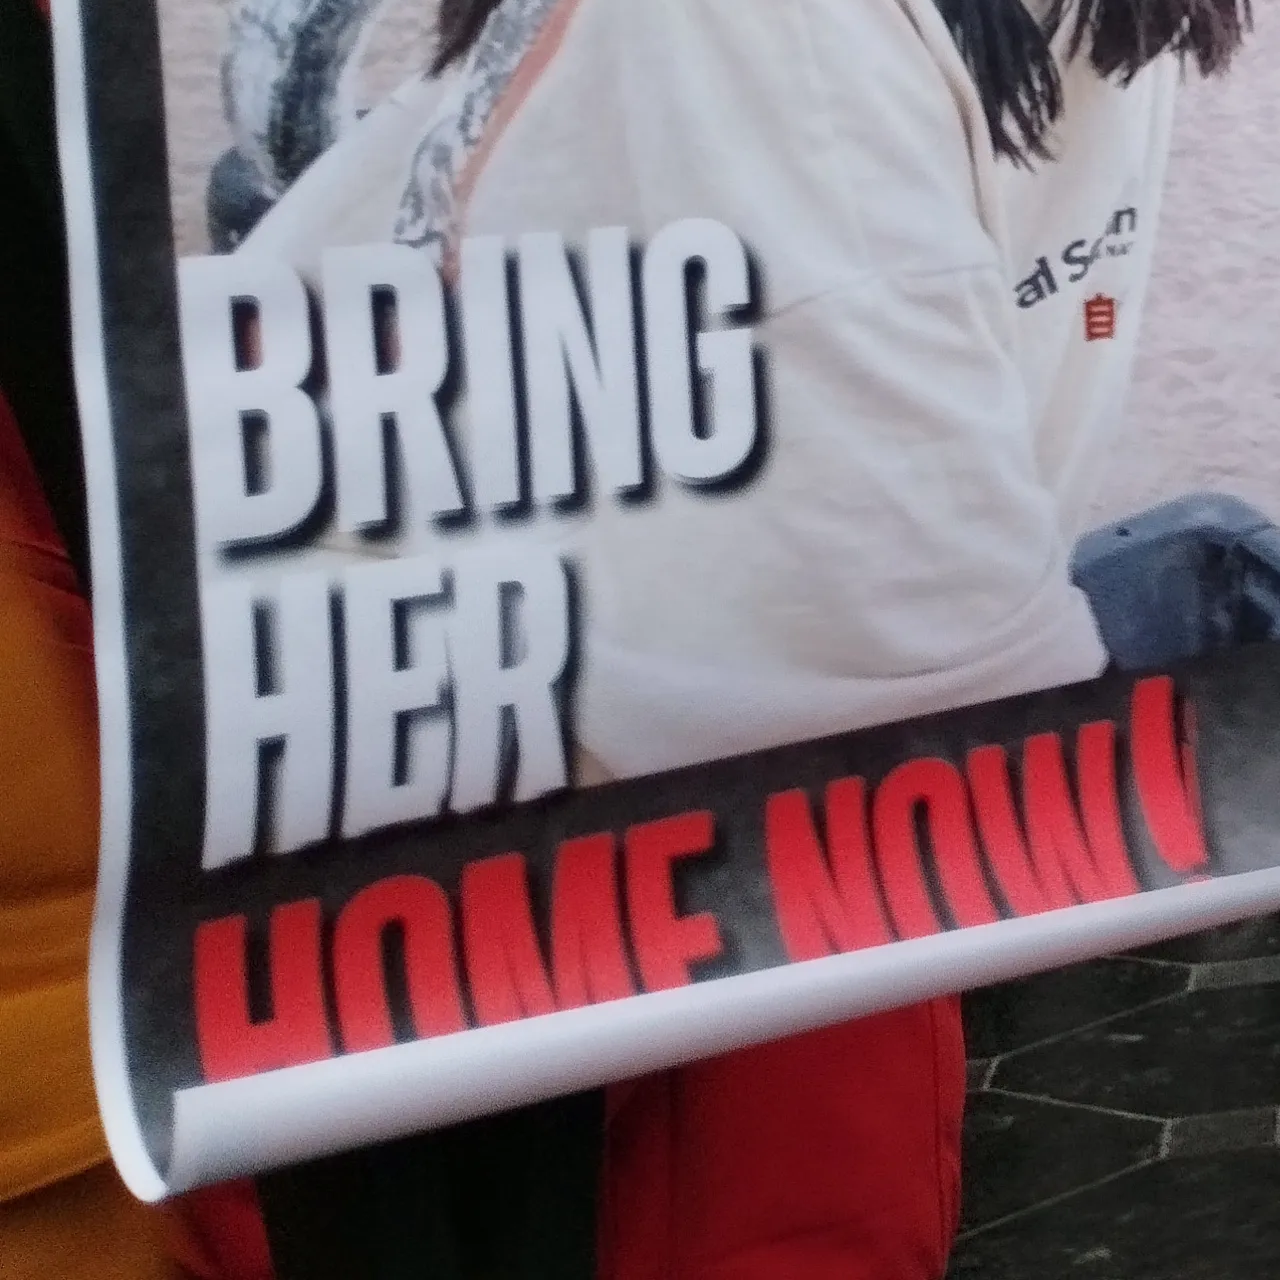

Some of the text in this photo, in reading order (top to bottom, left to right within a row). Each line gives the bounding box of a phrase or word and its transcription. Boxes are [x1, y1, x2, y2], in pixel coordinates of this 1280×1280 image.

[180, 218, 763, 552] BRING
[200, 554, 572, 870] HER
[196, 810, 720, 1084] HOME
